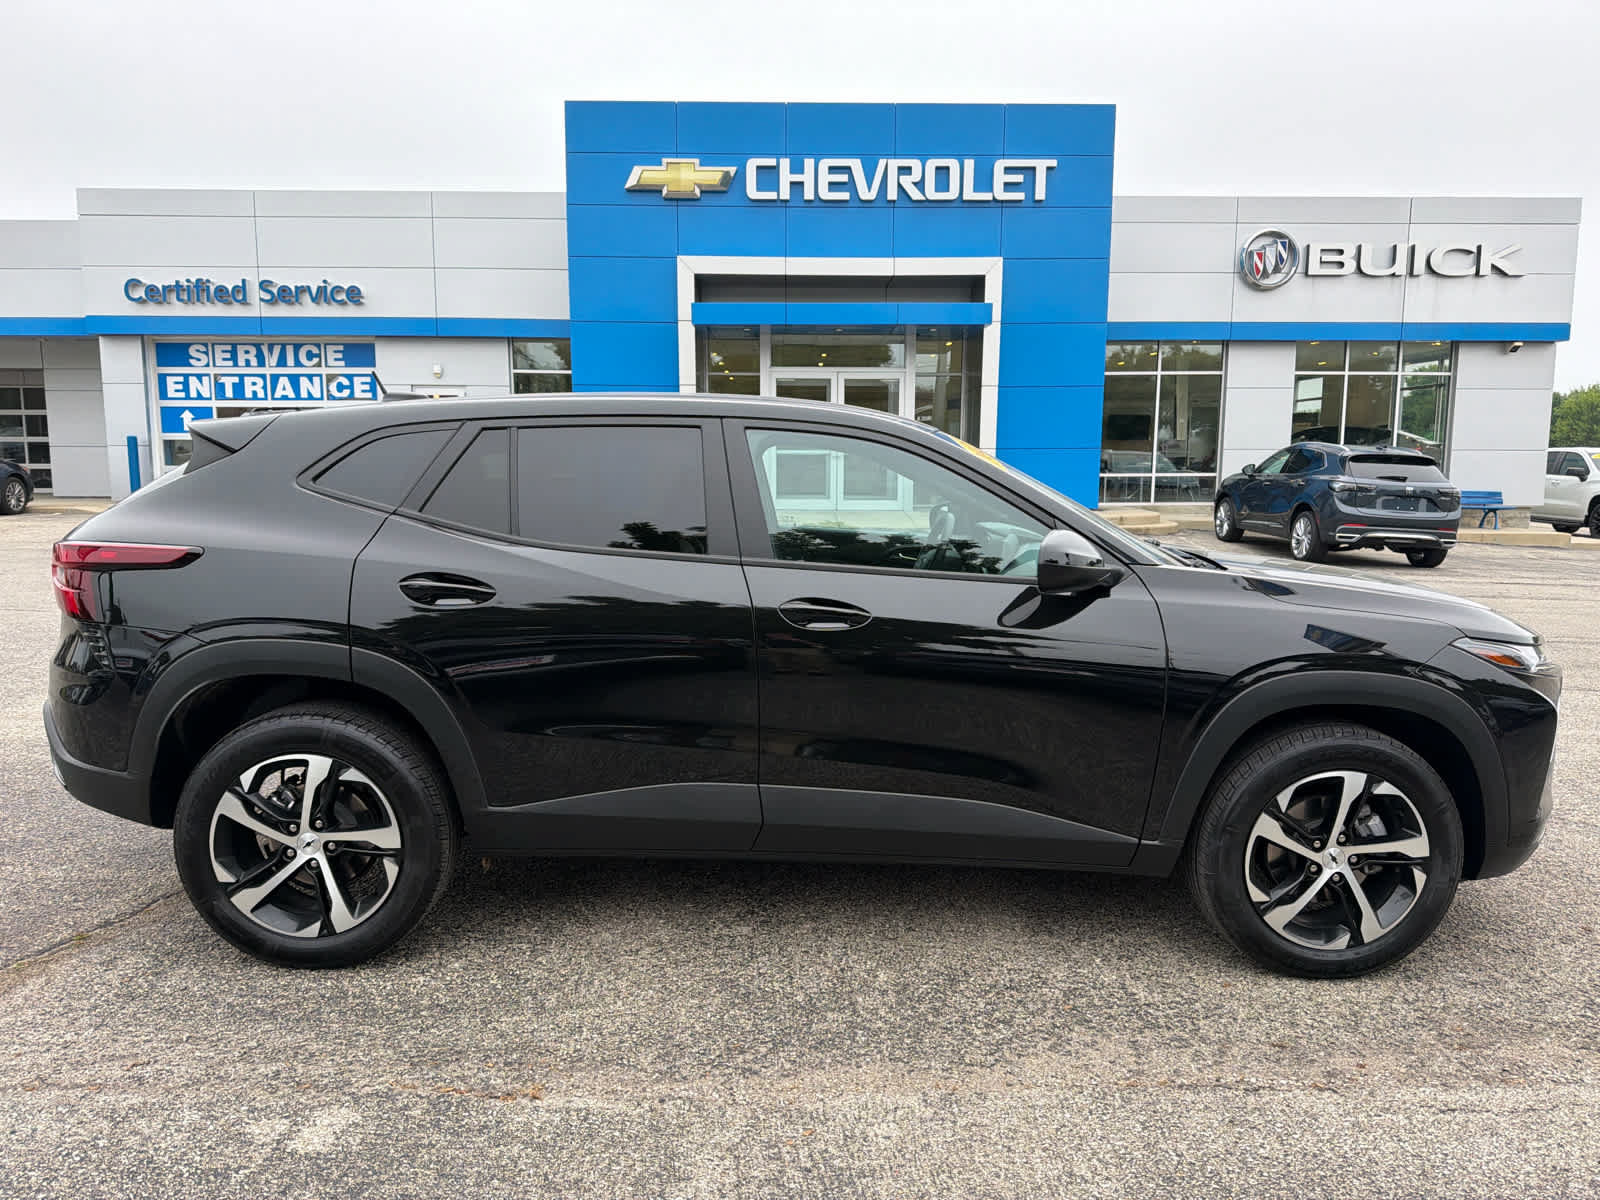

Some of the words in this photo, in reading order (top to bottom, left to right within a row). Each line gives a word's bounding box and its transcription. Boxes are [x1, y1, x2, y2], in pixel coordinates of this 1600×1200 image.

[745, 158, 1058, 202] CHEVROLET
[1305, 243, 1523, 277] BUICK
[123, 278, 248, 304] Certified
[258, 279, 363, 305] Service
[188, 344, 345, 367] SERVICE
[166, 375, 373, 399] ENTRANCE
